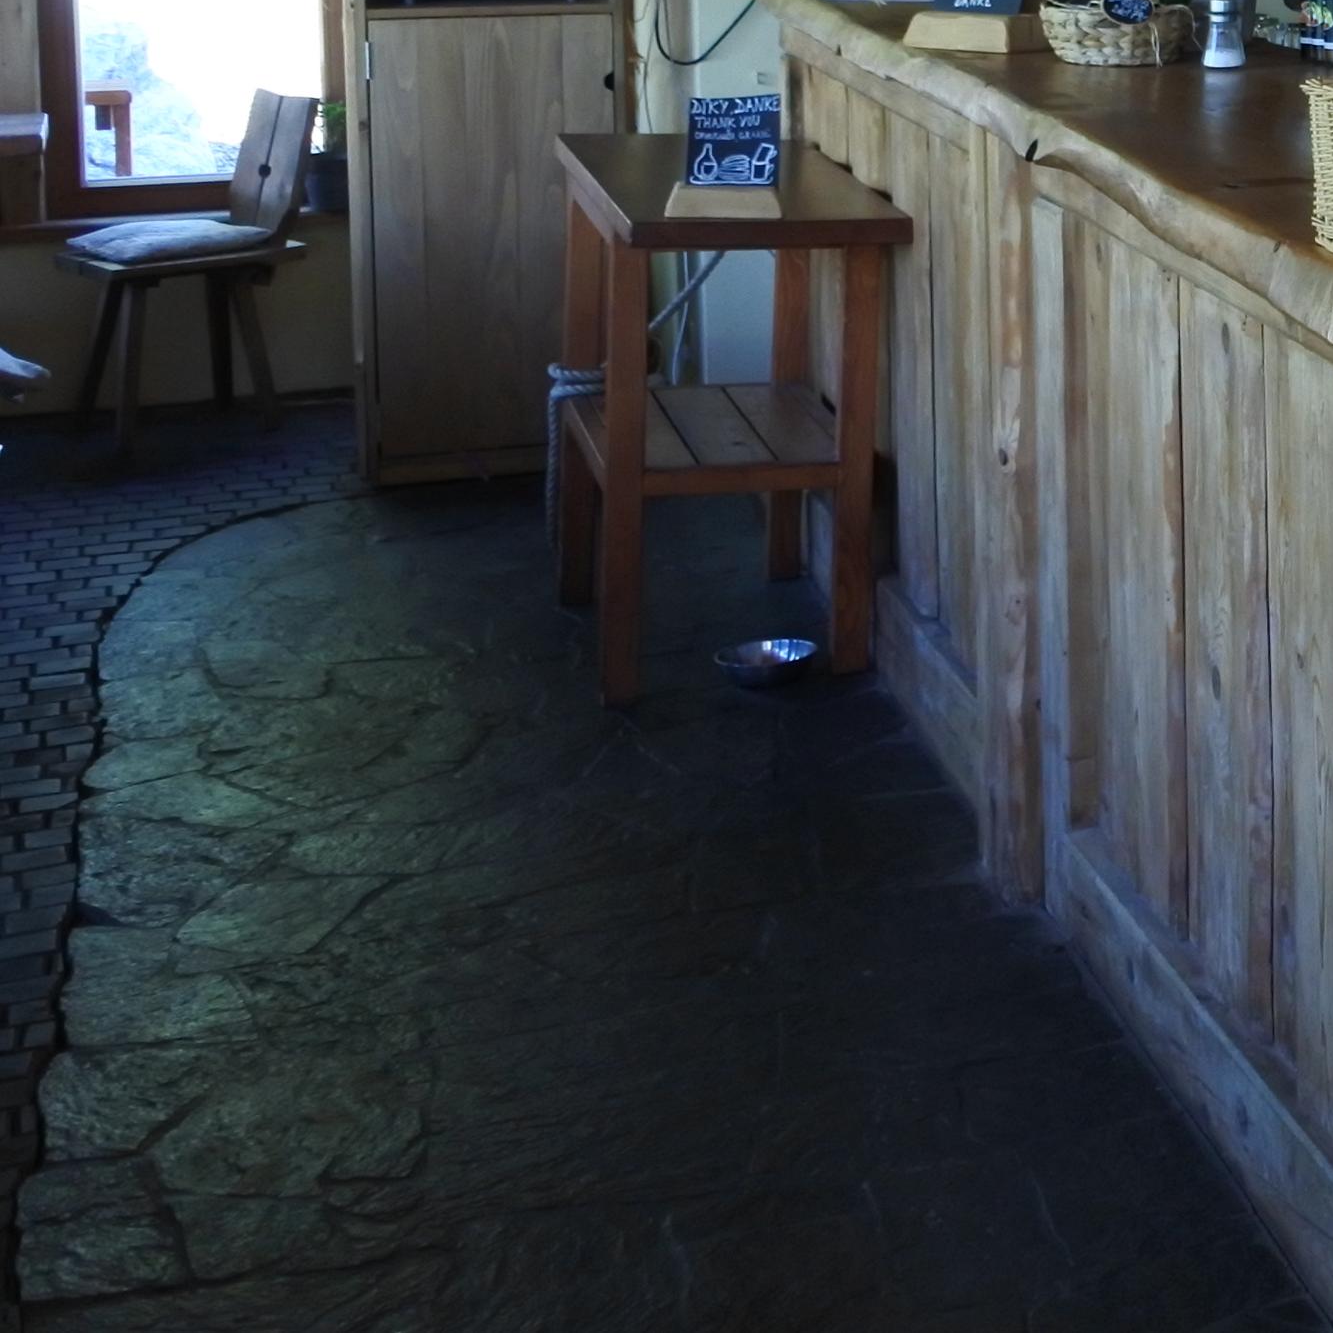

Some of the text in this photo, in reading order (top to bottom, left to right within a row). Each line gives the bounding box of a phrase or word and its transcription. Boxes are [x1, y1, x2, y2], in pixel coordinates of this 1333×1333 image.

[734, 95, 780, 114] DANKE
[694, 114, 760, 129] THANK YOU
